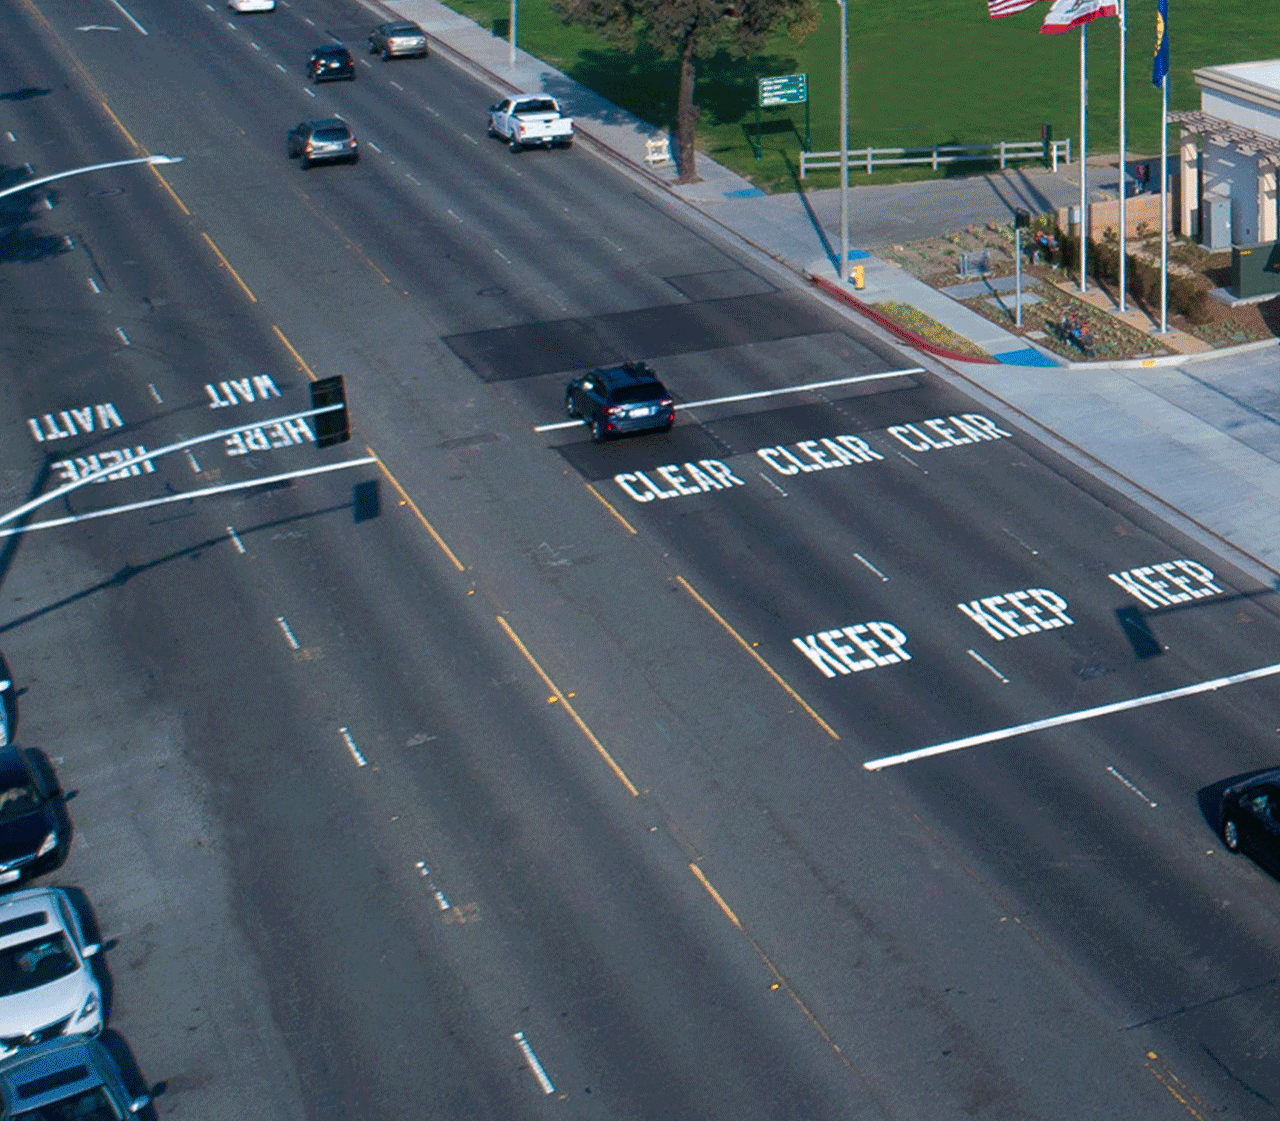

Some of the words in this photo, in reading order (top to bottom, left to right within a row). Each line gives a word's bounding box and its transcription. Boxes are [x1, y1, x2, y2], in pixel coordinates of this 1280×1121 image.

[757, 435, 884, 477] CLEAR
[886, 413, 1012, 453] CLEAR
[614, 459, 744, 503] CLEAR
[1109, 558, 1224, 608] KEEP
[958, 588, 1074, 640] KEEP
[792, 621, 912, 678] KEEP
